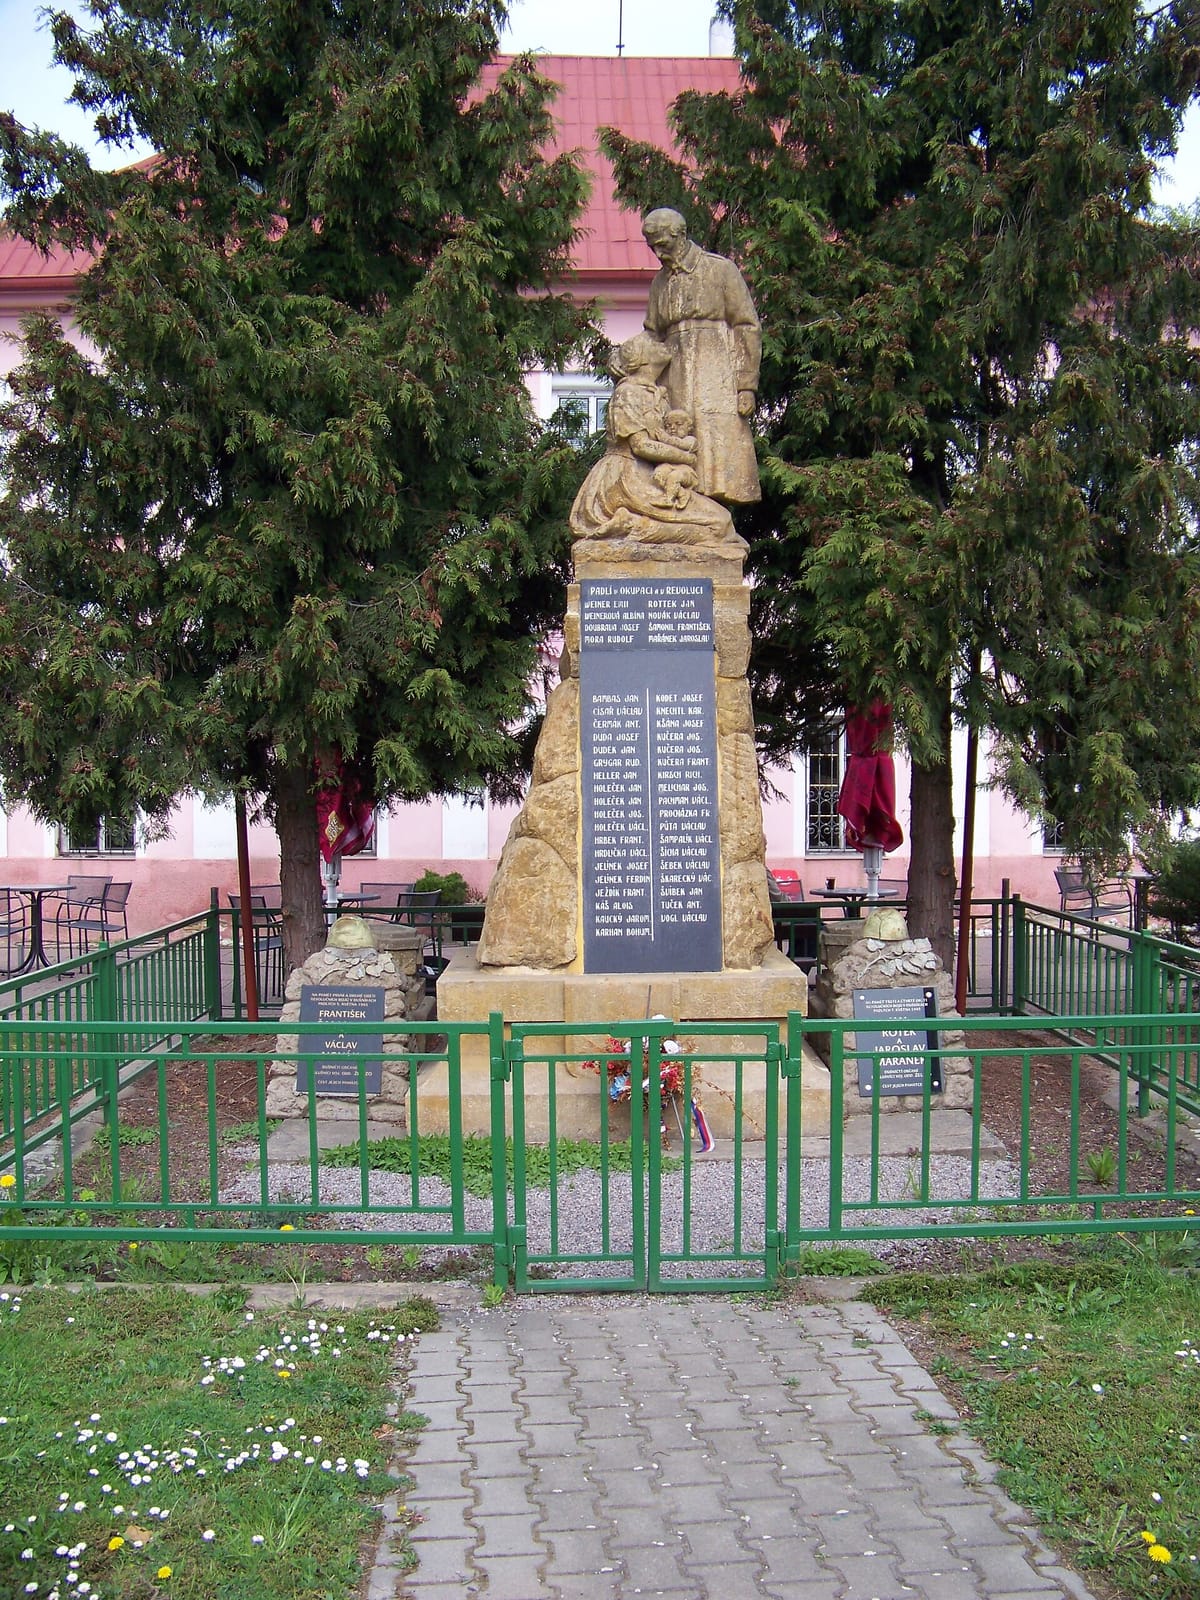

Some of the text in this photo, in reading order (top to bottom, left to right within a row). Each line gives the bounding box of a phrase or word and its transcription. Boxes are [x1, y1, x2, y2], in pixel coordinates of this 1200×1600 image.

[590, 585, 612, 595] PADLÍ
[620, 586, 653, 595] OKUPACI
[666, 586, 703, 595] REVOLUCI
[648, 600, 695, 608] ROTTEK JAN
[648, 610, 671, 620] NOVÁK
[677, 622, 712, 631] FRANTIŠEK
[608, 635, 634, 643] RUDOLF
[625, 695, 639, 703] JAN
[682, 693, 704, 702] JOSEF
[683, 719, 704, 728] JOSEF
[616, 733, 640, 741] JOSEF
[657, 730, 684, 741] KUČERA
[621, 746, 636, 754] JAN
[657, 743, 684, 754] KUČERA
[658, 756, 684, 767] KUČERA
[593, 771, 637, 780] HELLER JAN
[628, 784, 642, 793] JAN
[628, 797, 642, 805] JAN
[626, 862, 649, 870] JOSEF
[660, 860, 683, 870] ŠEBEK
[689, 888, 703, 896] JAN
[613, 902, 634, 910] ALOIS
[661, 914, 678, 922] VOGL
[320, 1010, 366, 1018] FRANTIŠEK
[325, 1041, 358, 1049] VÁCLAV
